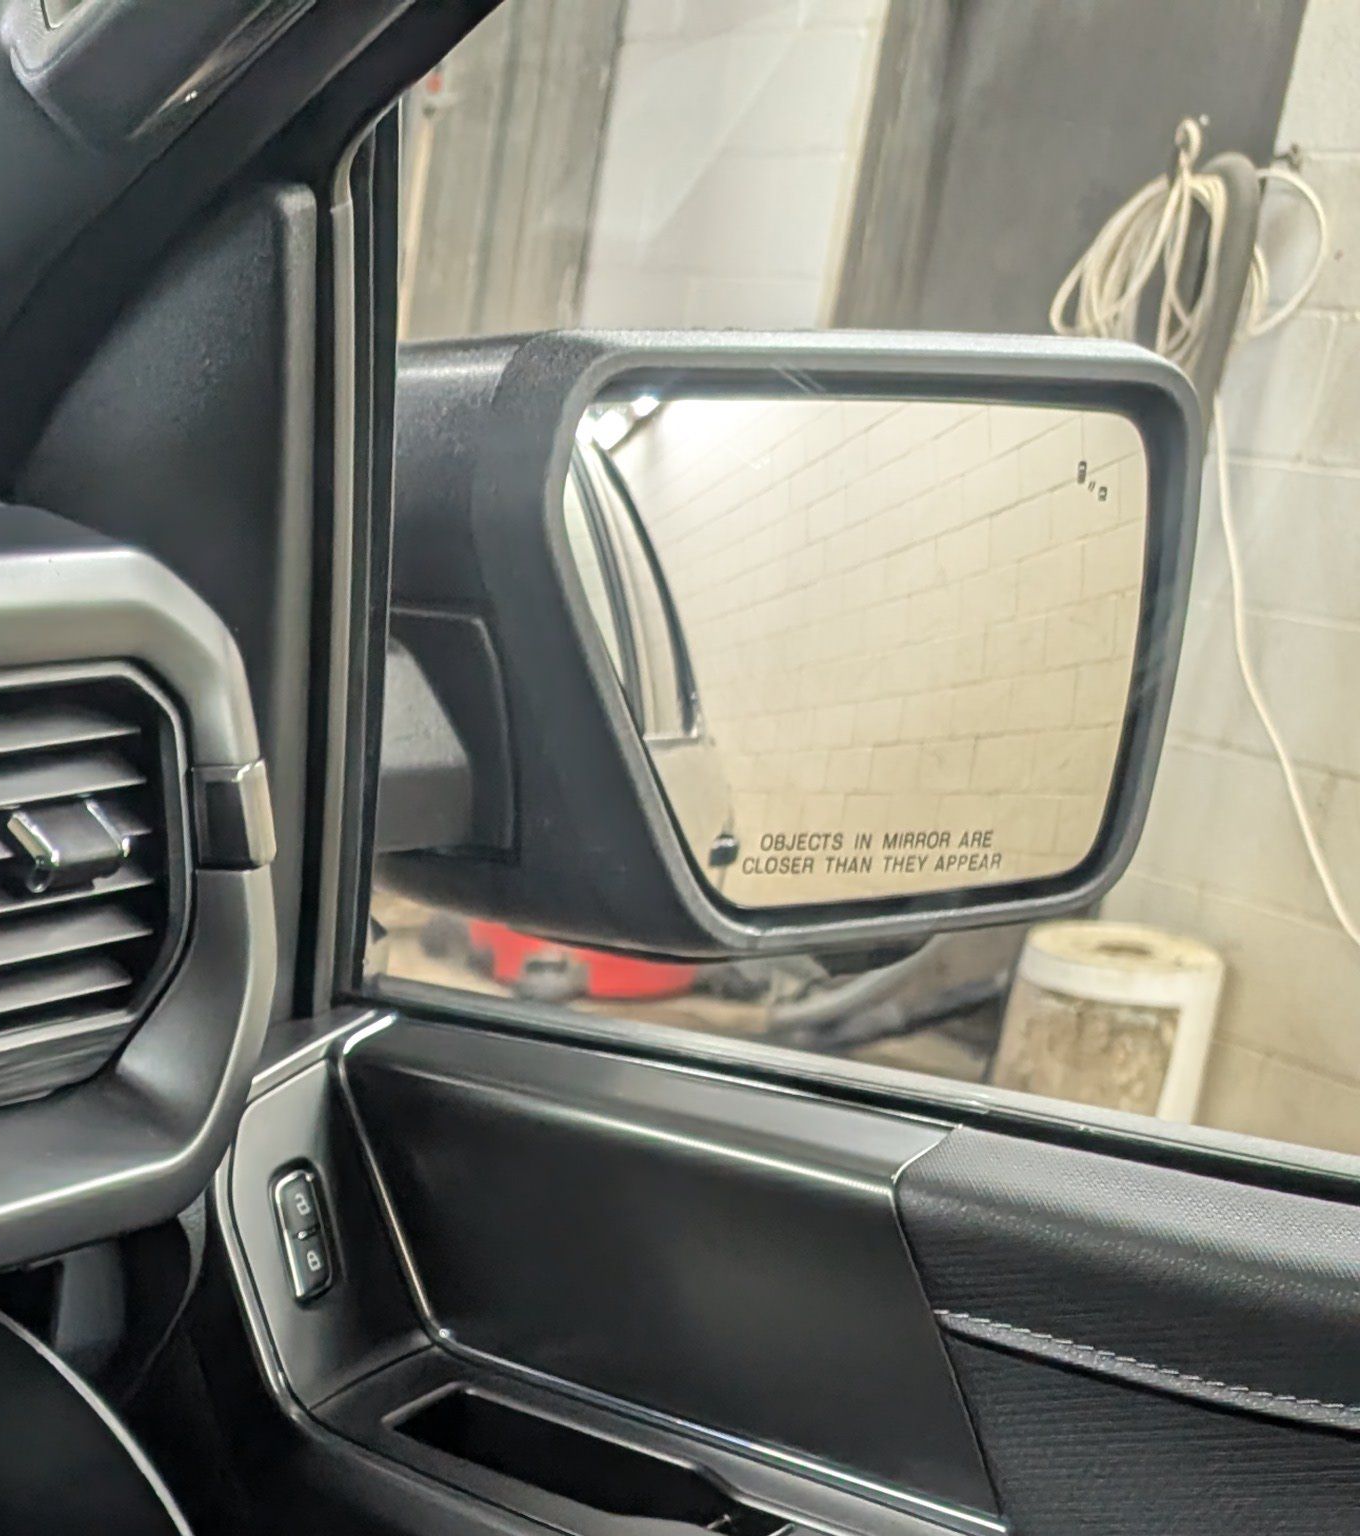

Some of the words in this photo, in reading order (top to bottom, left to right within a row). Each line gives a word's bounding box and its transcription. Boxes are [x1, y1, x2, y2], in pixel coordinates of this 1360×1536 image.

[760, 832, 844, 852] OBJECTS
[854, 832, 873, 850] IN
[882, 831, 951, 850] MIRROR
[958, 829, 994, 849] ARE
[742, 856, 814, 875] CLOSER
[825, 856, 873, 874] THAN
[883, 854, 928, 873] THEY
[934, 853, 1002, 872] APPEAR
